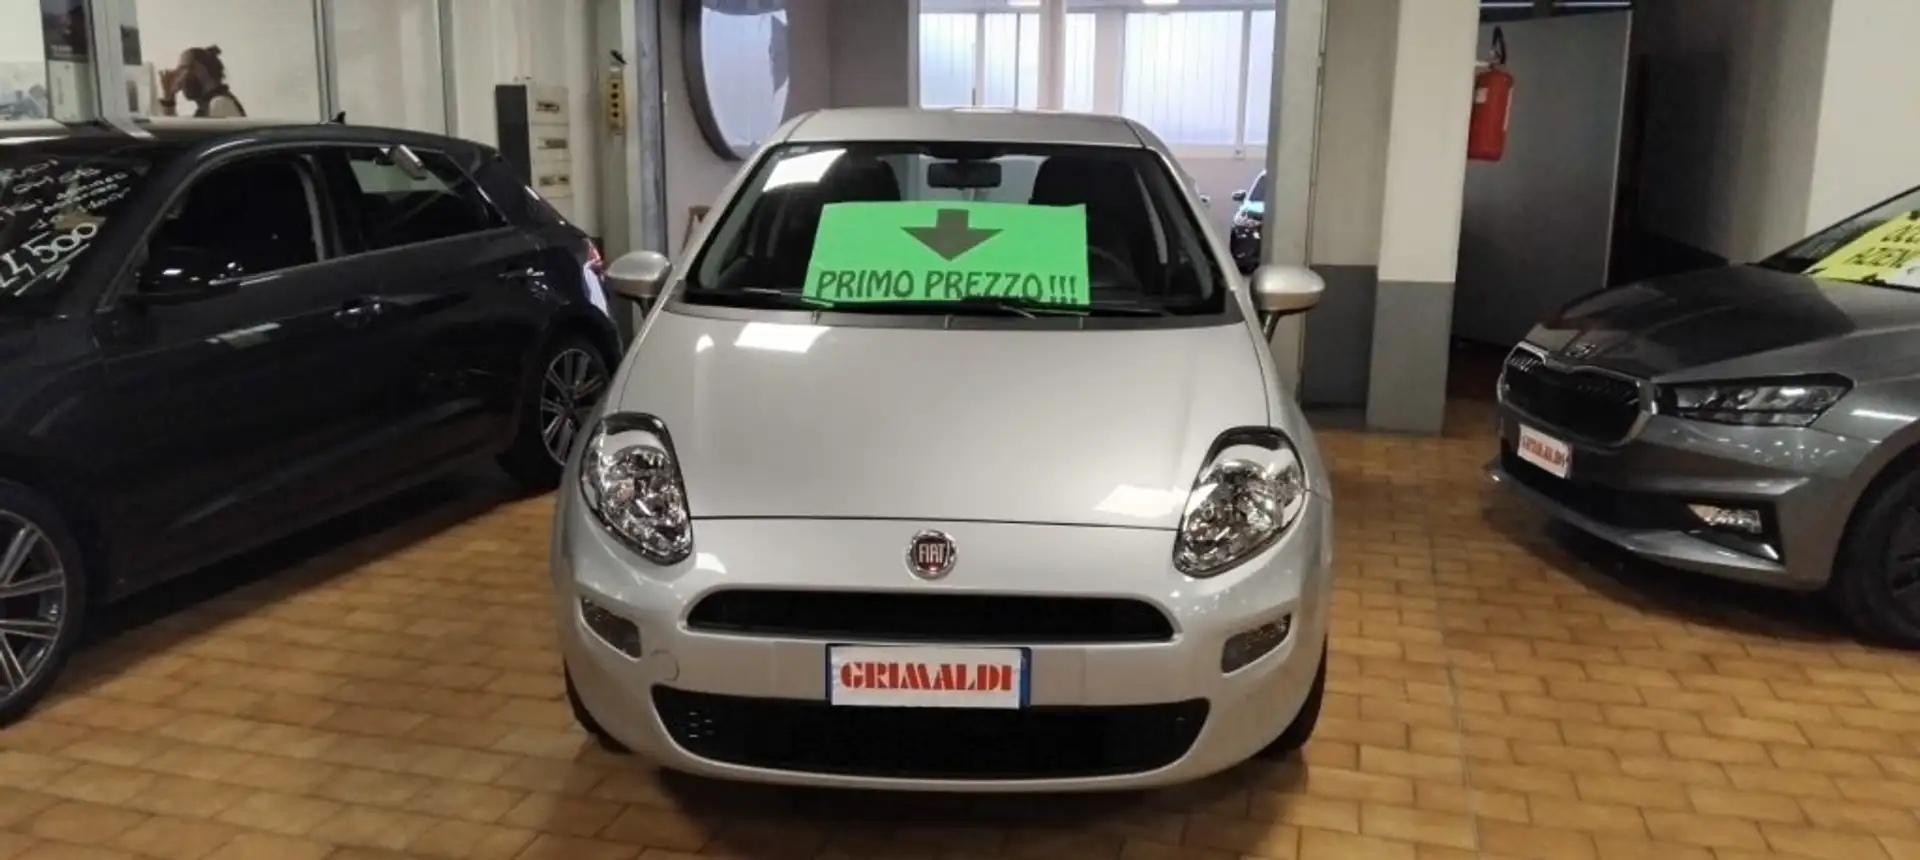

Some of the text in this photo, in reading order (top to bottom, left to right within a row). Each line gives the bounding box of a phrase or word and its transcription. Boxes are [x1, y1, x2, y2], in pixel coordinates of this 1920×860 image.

[815, 270, 915, 299] PRIMO
[917, 543, 947, 564] FIAT
[839, 660, 1013, 692] GRIMALDI
